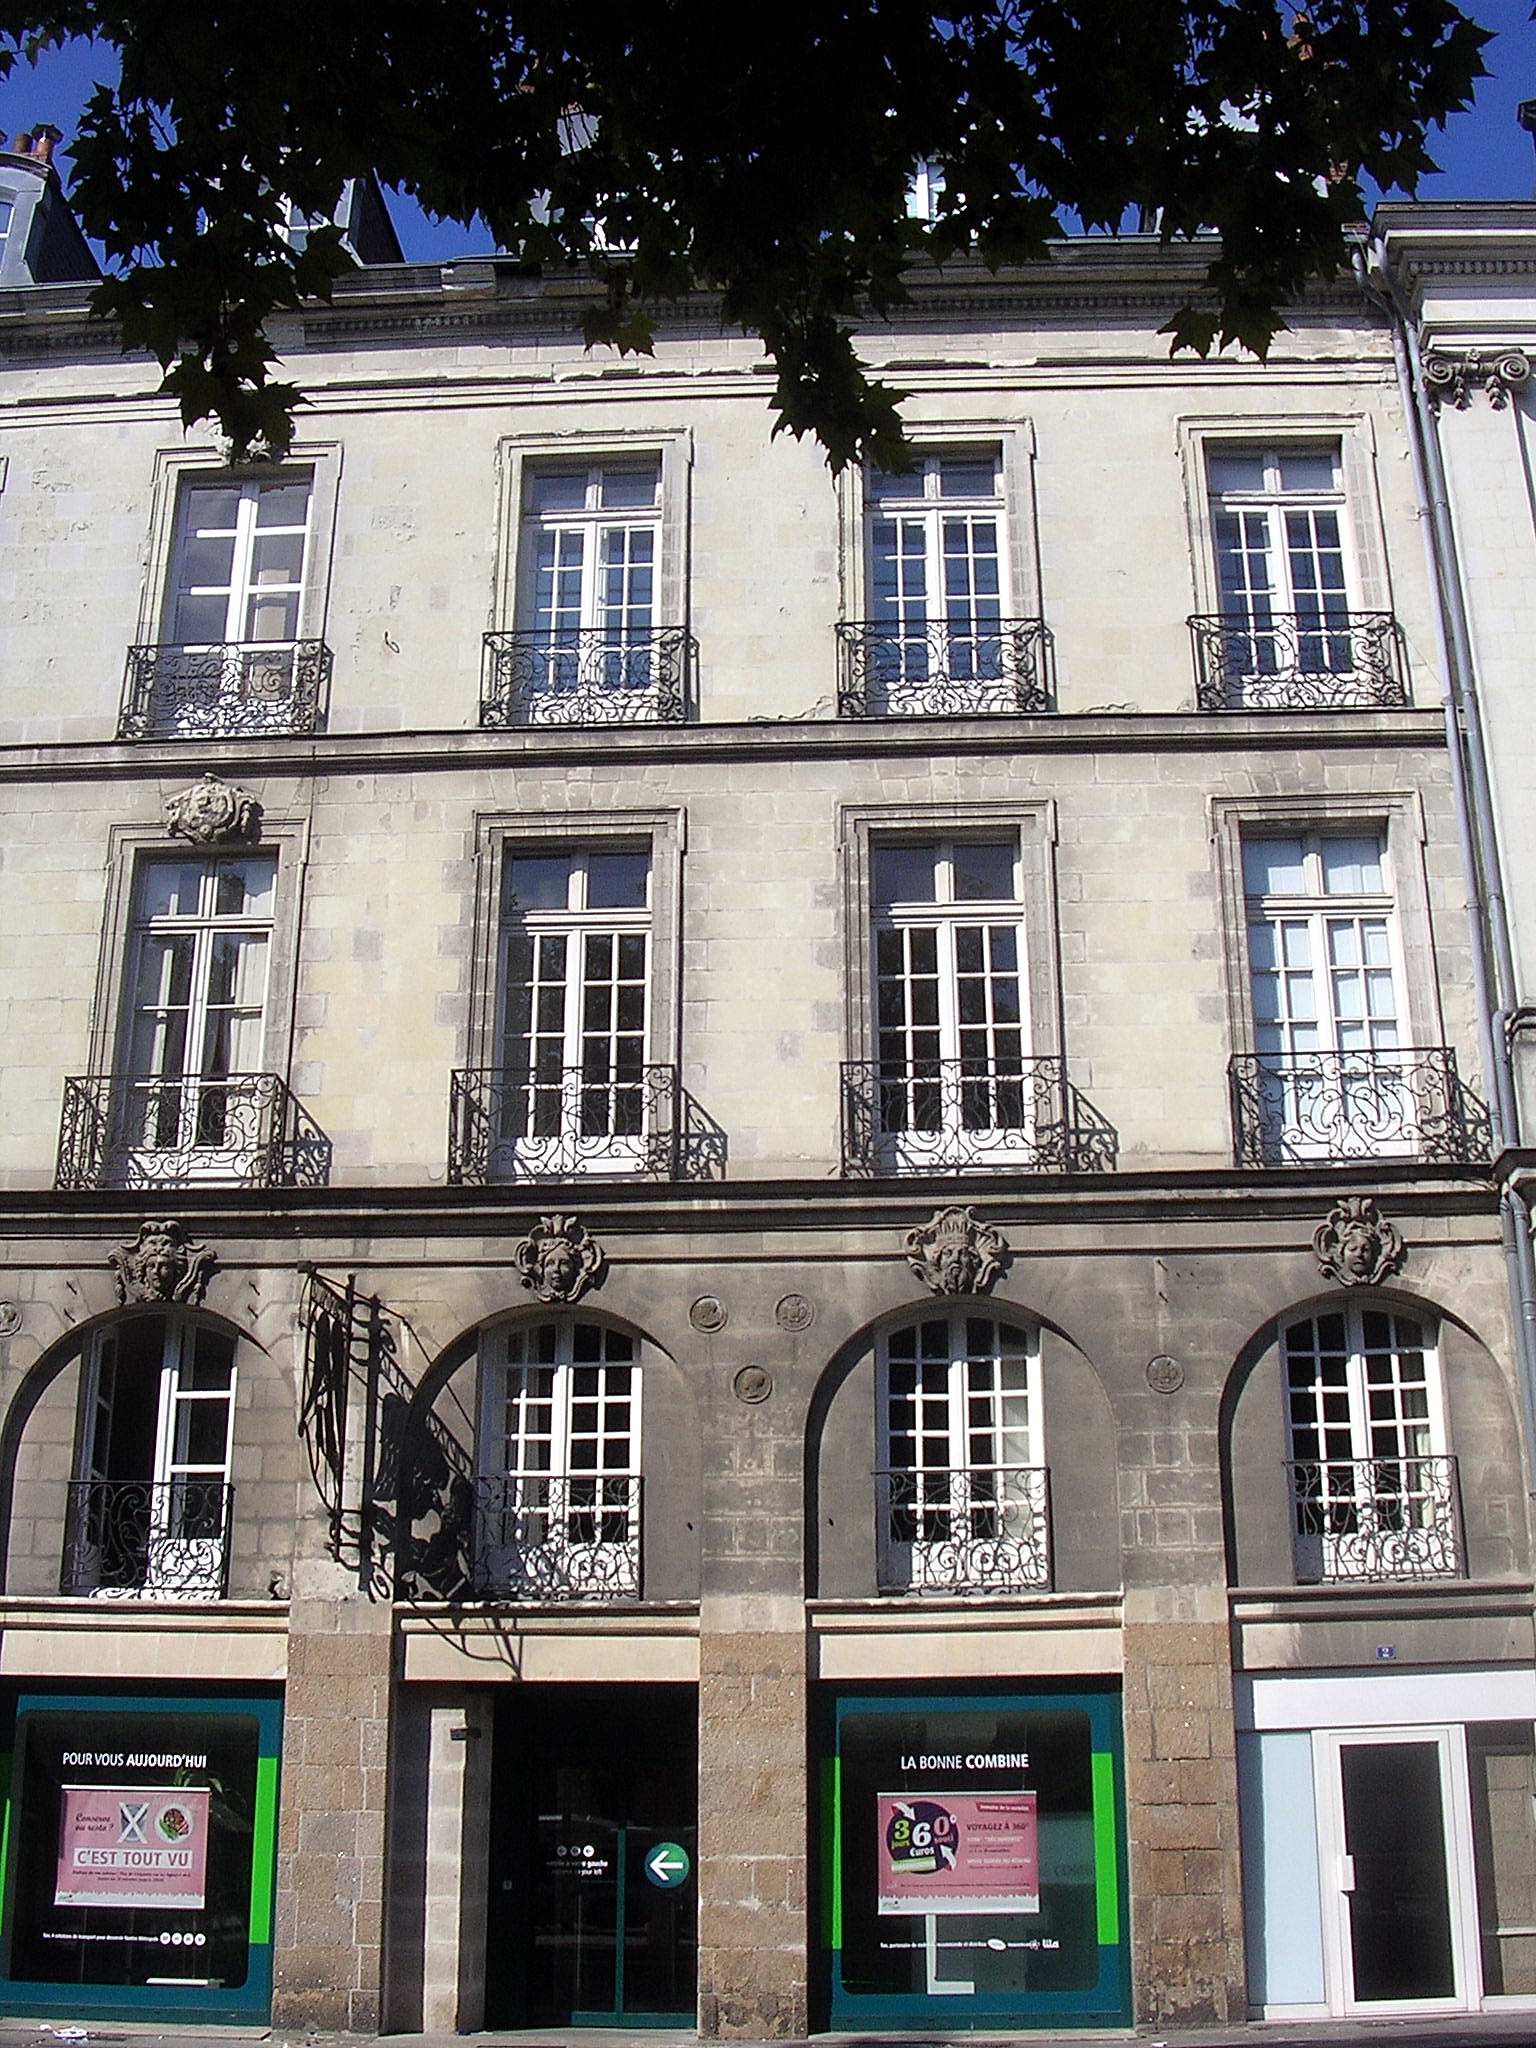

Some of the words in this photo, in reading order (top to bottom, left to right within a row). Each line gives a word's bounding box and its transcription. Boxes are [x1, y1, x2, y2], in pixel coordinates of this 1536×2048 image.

[62, 1752, 93, 1766] POUR
[94, 1753, 124, 1766] VOUS
[126, 1754, 207, 1768] AUJOURD'HUI
[901, 1756, 917, 1770] LA
[919, 1755, 963, 1769] BONNE
[965, 1754, 1029, 1769] COMBINE
[966, 1823, 1002, 1831] VOYAGEZ
[77, 1850, 117, 1865] C'EST
[123, 1851, 162, 1866] TOUT
[168, 1853, 189, 1866] VU
